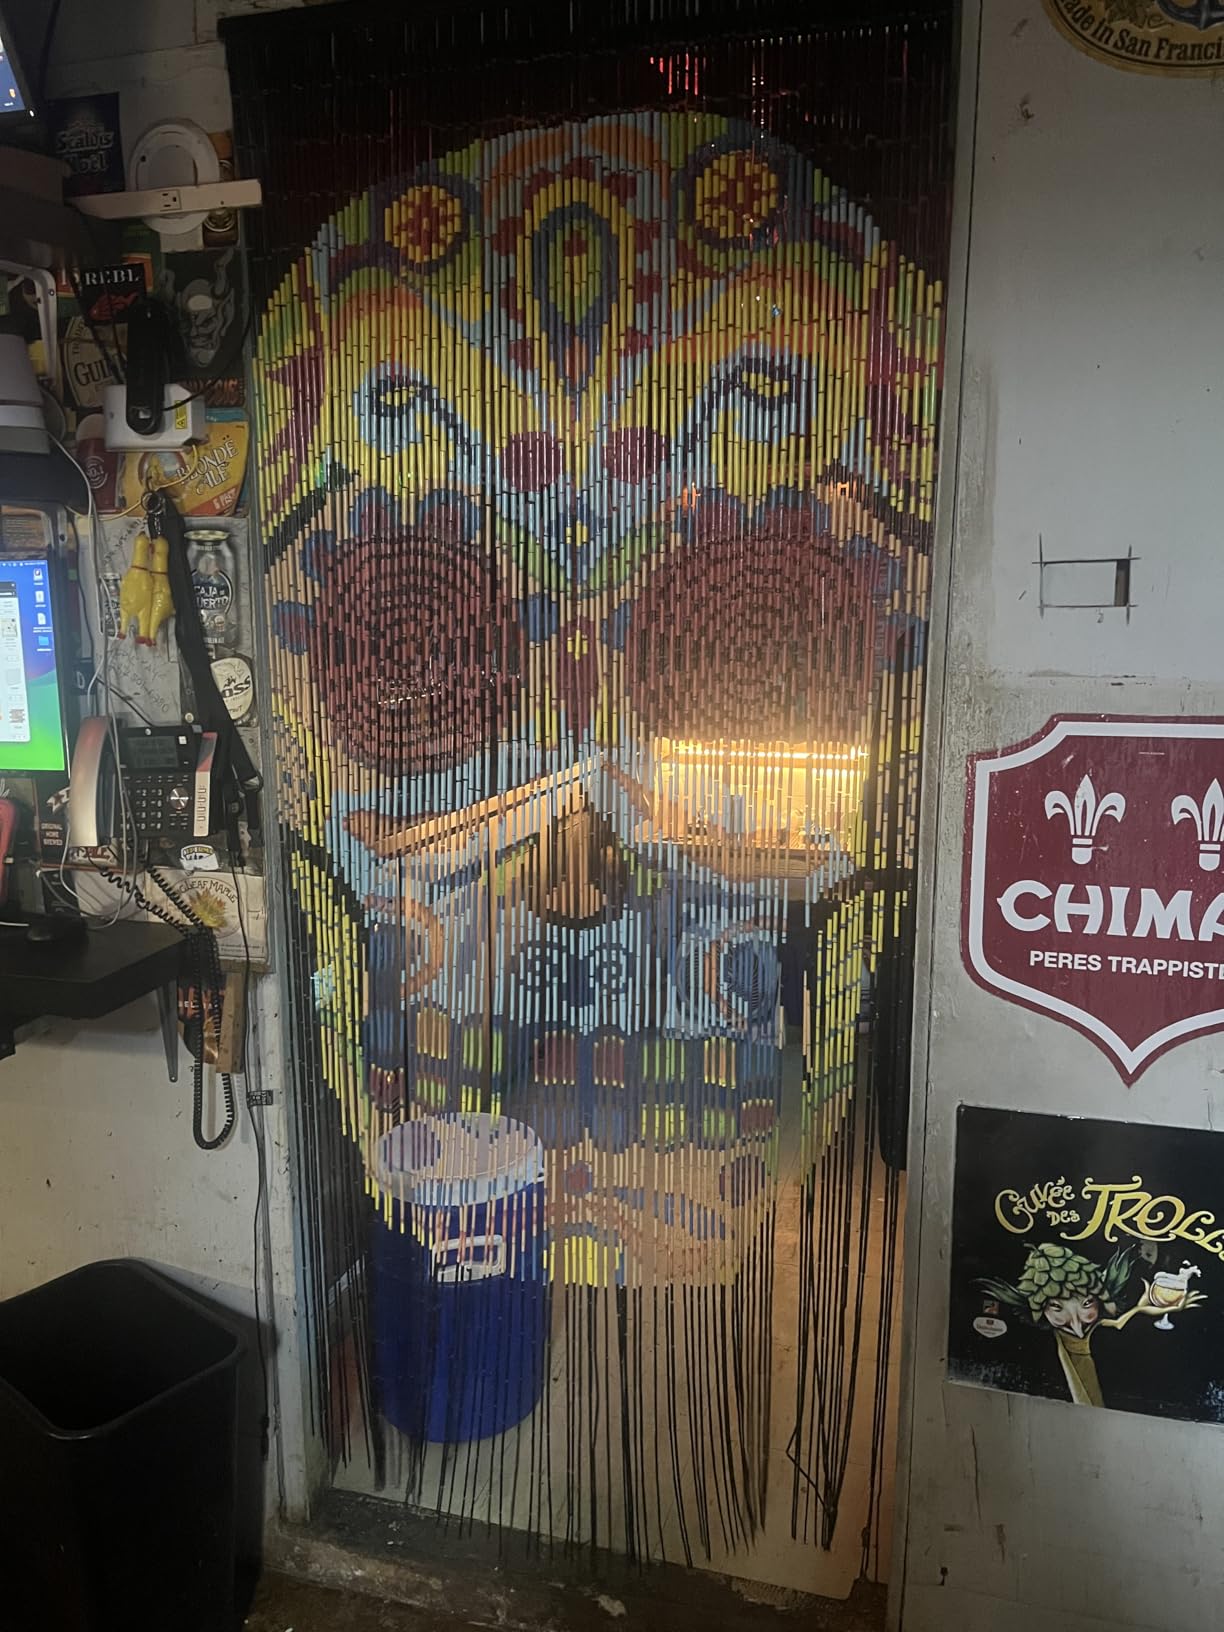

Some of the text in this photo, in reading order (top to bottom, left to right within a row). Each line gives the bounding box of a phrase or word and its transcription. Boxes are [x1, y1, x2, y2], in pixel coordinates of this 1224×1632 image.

[1060, 0, 1095, 31] ade
[1113, 28, 1151, 57] San
[1154, 37, 1224, 60] Franci
[194, 595, 229, 610] UERTO
[1029, 950, 1102, 972] PERES
[1060, 1175, 1224, 1262] TROLL
